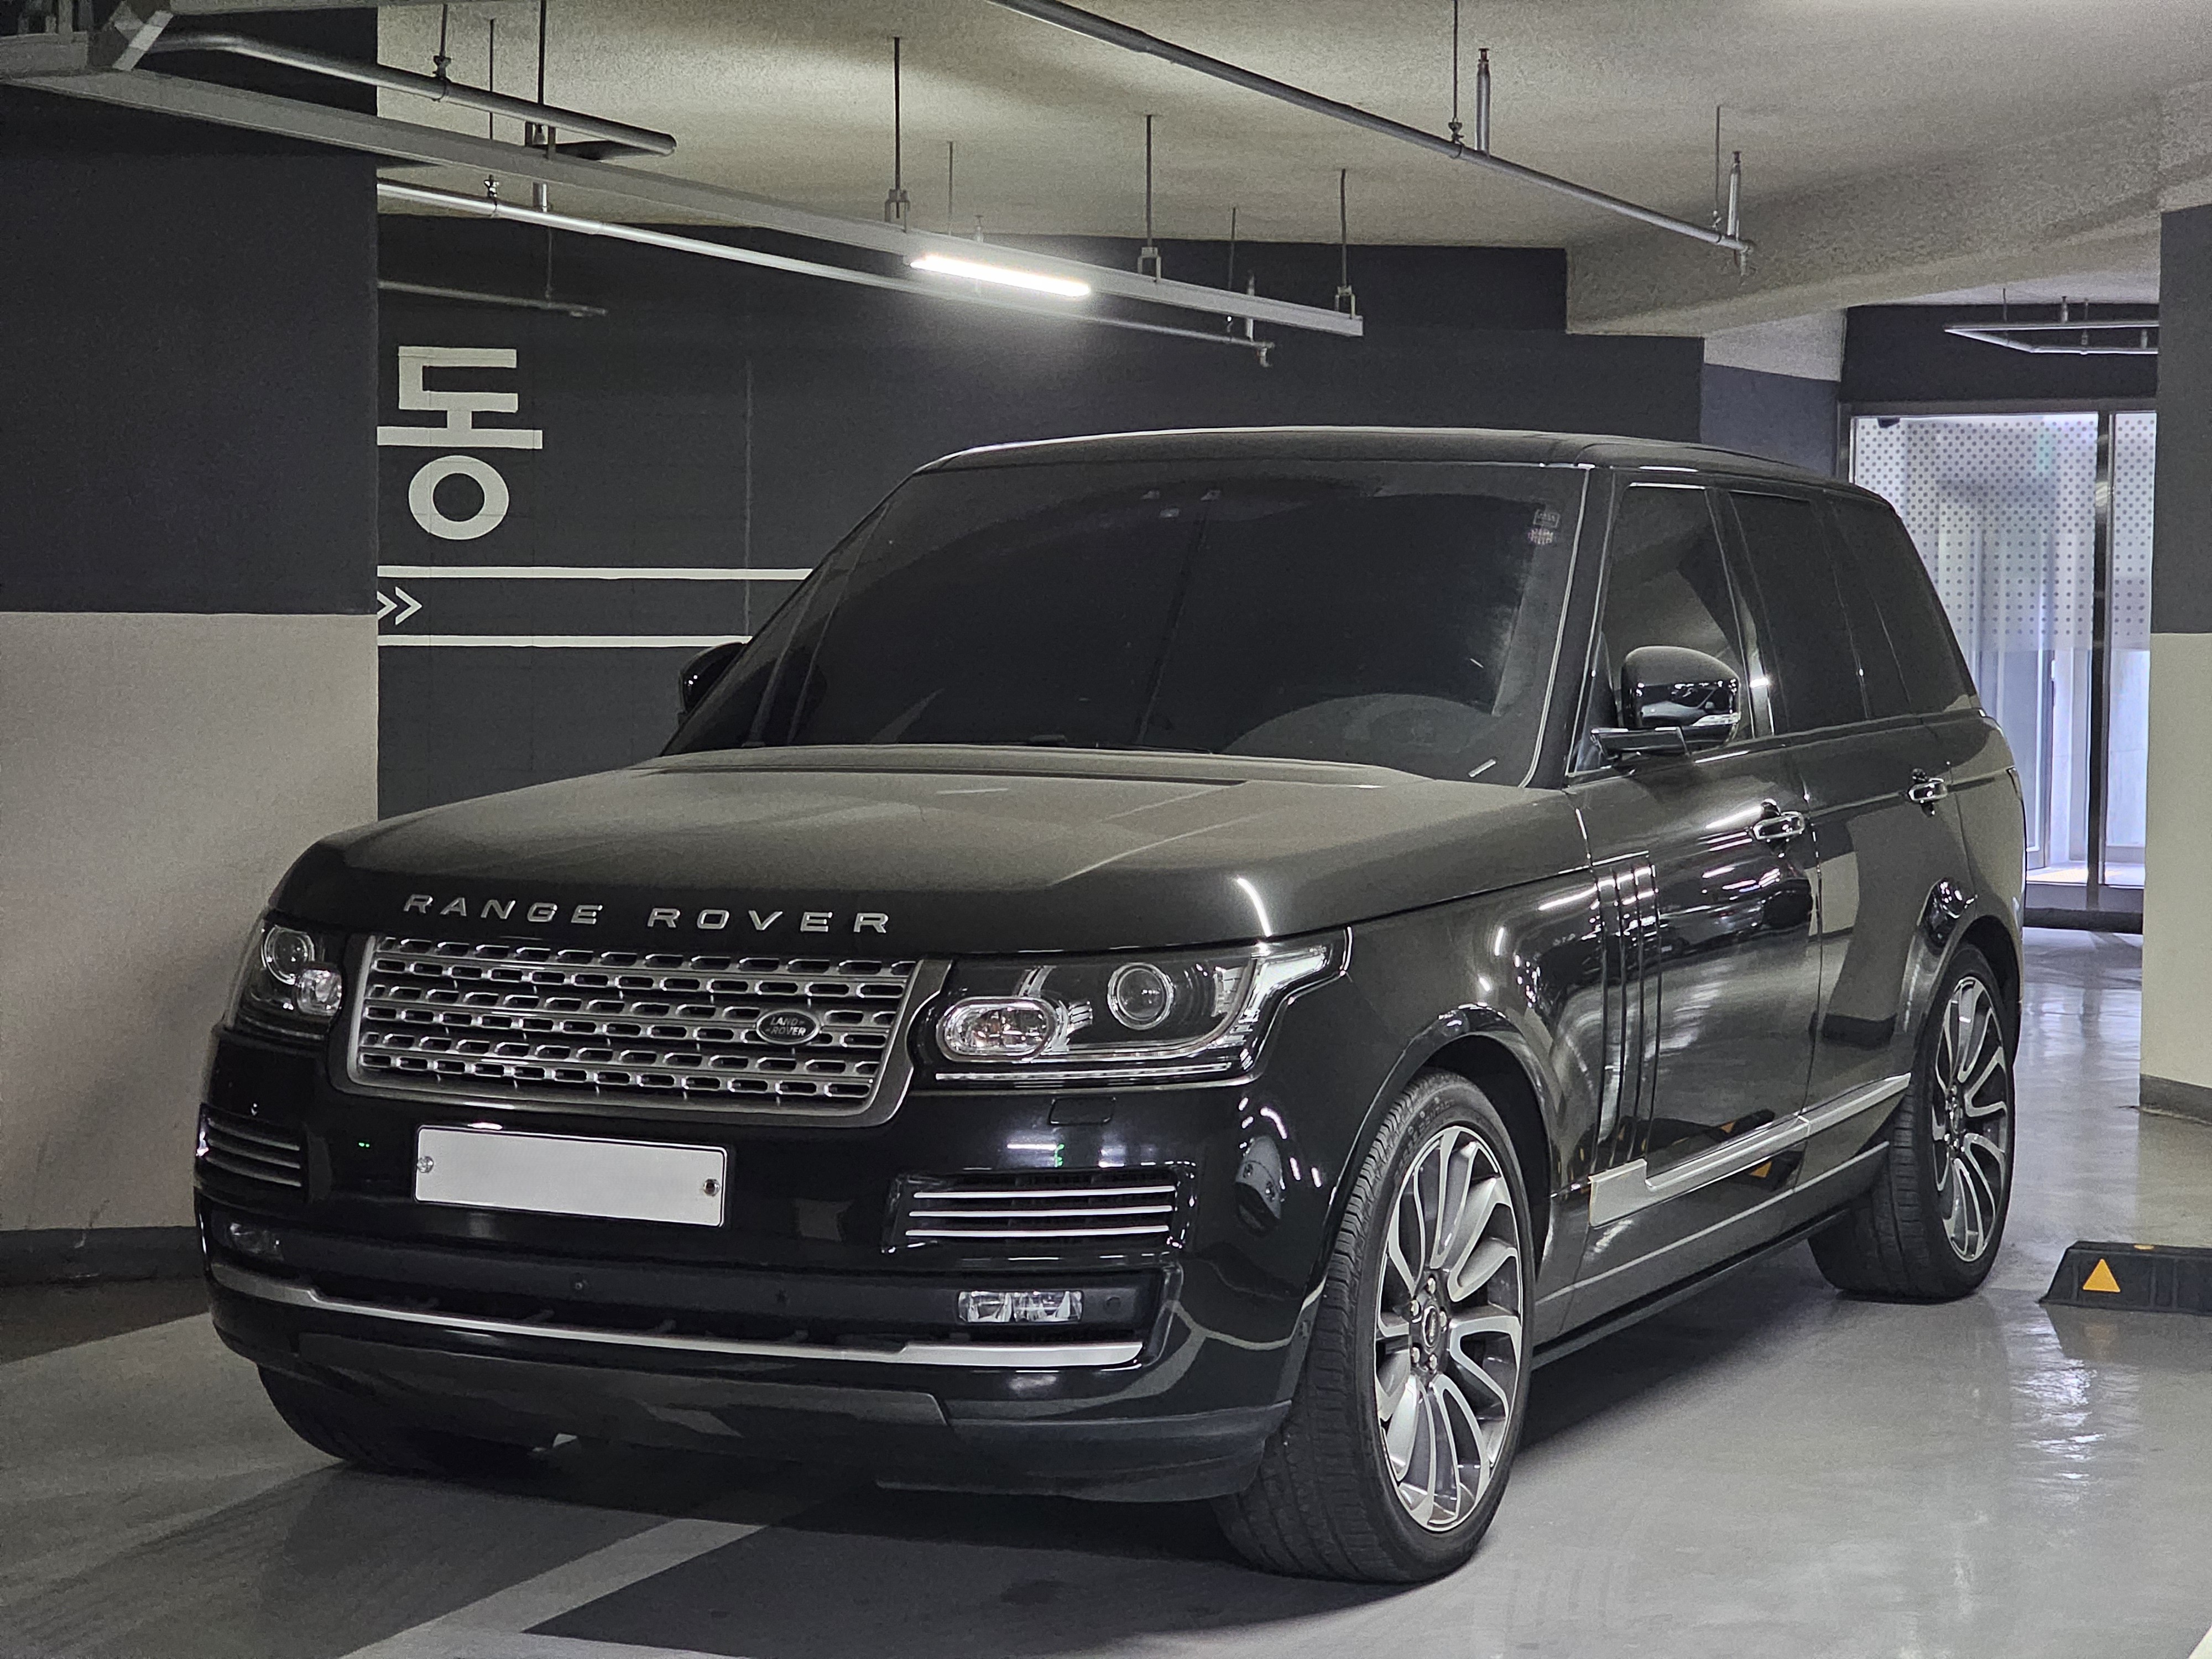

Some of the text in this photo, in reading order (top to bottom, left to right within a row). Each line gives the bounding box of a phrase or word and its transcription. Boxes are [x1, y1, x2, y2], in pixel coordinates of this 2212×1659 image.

[377, 346, 542, 540] 동
[403, 894, 889, 933] RANGE ROVER
